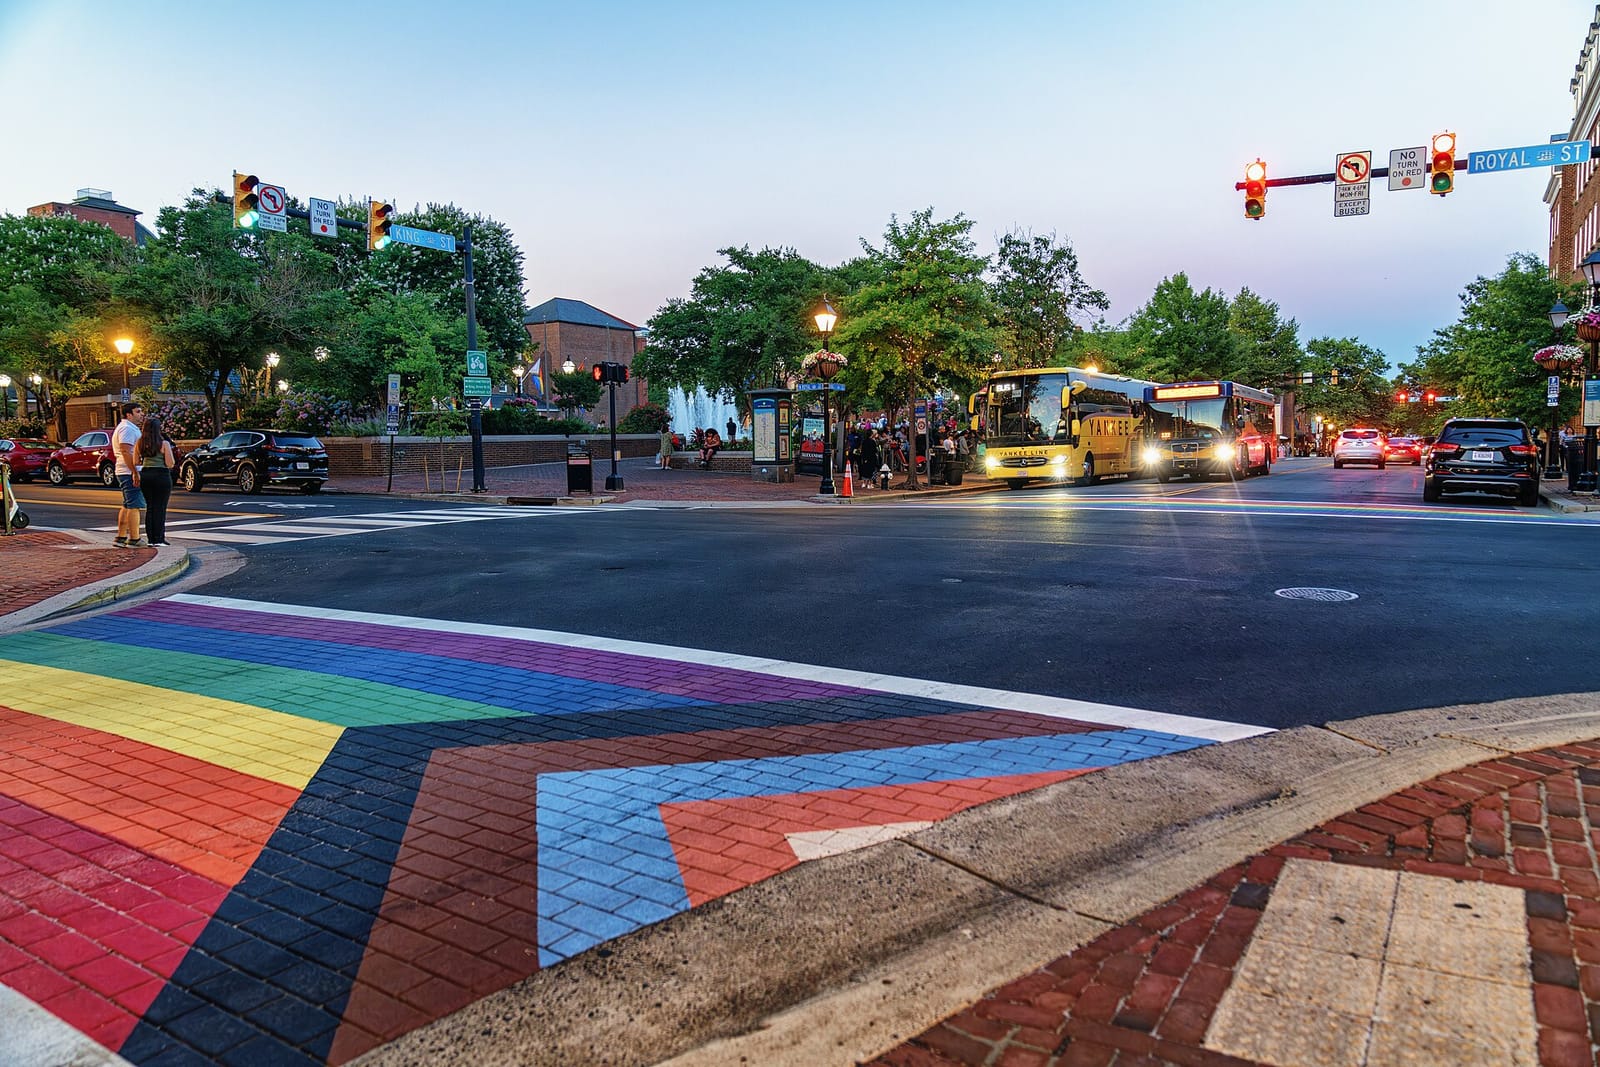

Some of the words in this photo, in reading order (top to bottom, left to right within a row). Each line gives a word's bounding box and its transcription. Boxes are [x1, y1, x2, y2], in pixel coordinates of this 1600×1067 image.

[1400, 150, 1416, 161] NO
[1474, 150, 1531, 171] ROYAL
[1560, 143, 1583, 162] ST
[1397, 160, 1418, 169] TURN
[1392, 170, 1404, 178] ON
[1406, 168, 1422, 177] RED
[317, 201, 329, 210] NO
[1339, 200, 1366, 208] EXCEPT
[316, 209, 331, 218] TURN
[1339, 206, 1366, 215] BUSES
[313, 216, 322, 224] ON
[322, 218, 334, 226] RED
[395, 227, 420, 243] KING
[440, 236, 451, 251] ST
[1089, 419, 1129, 436] YANKEE
